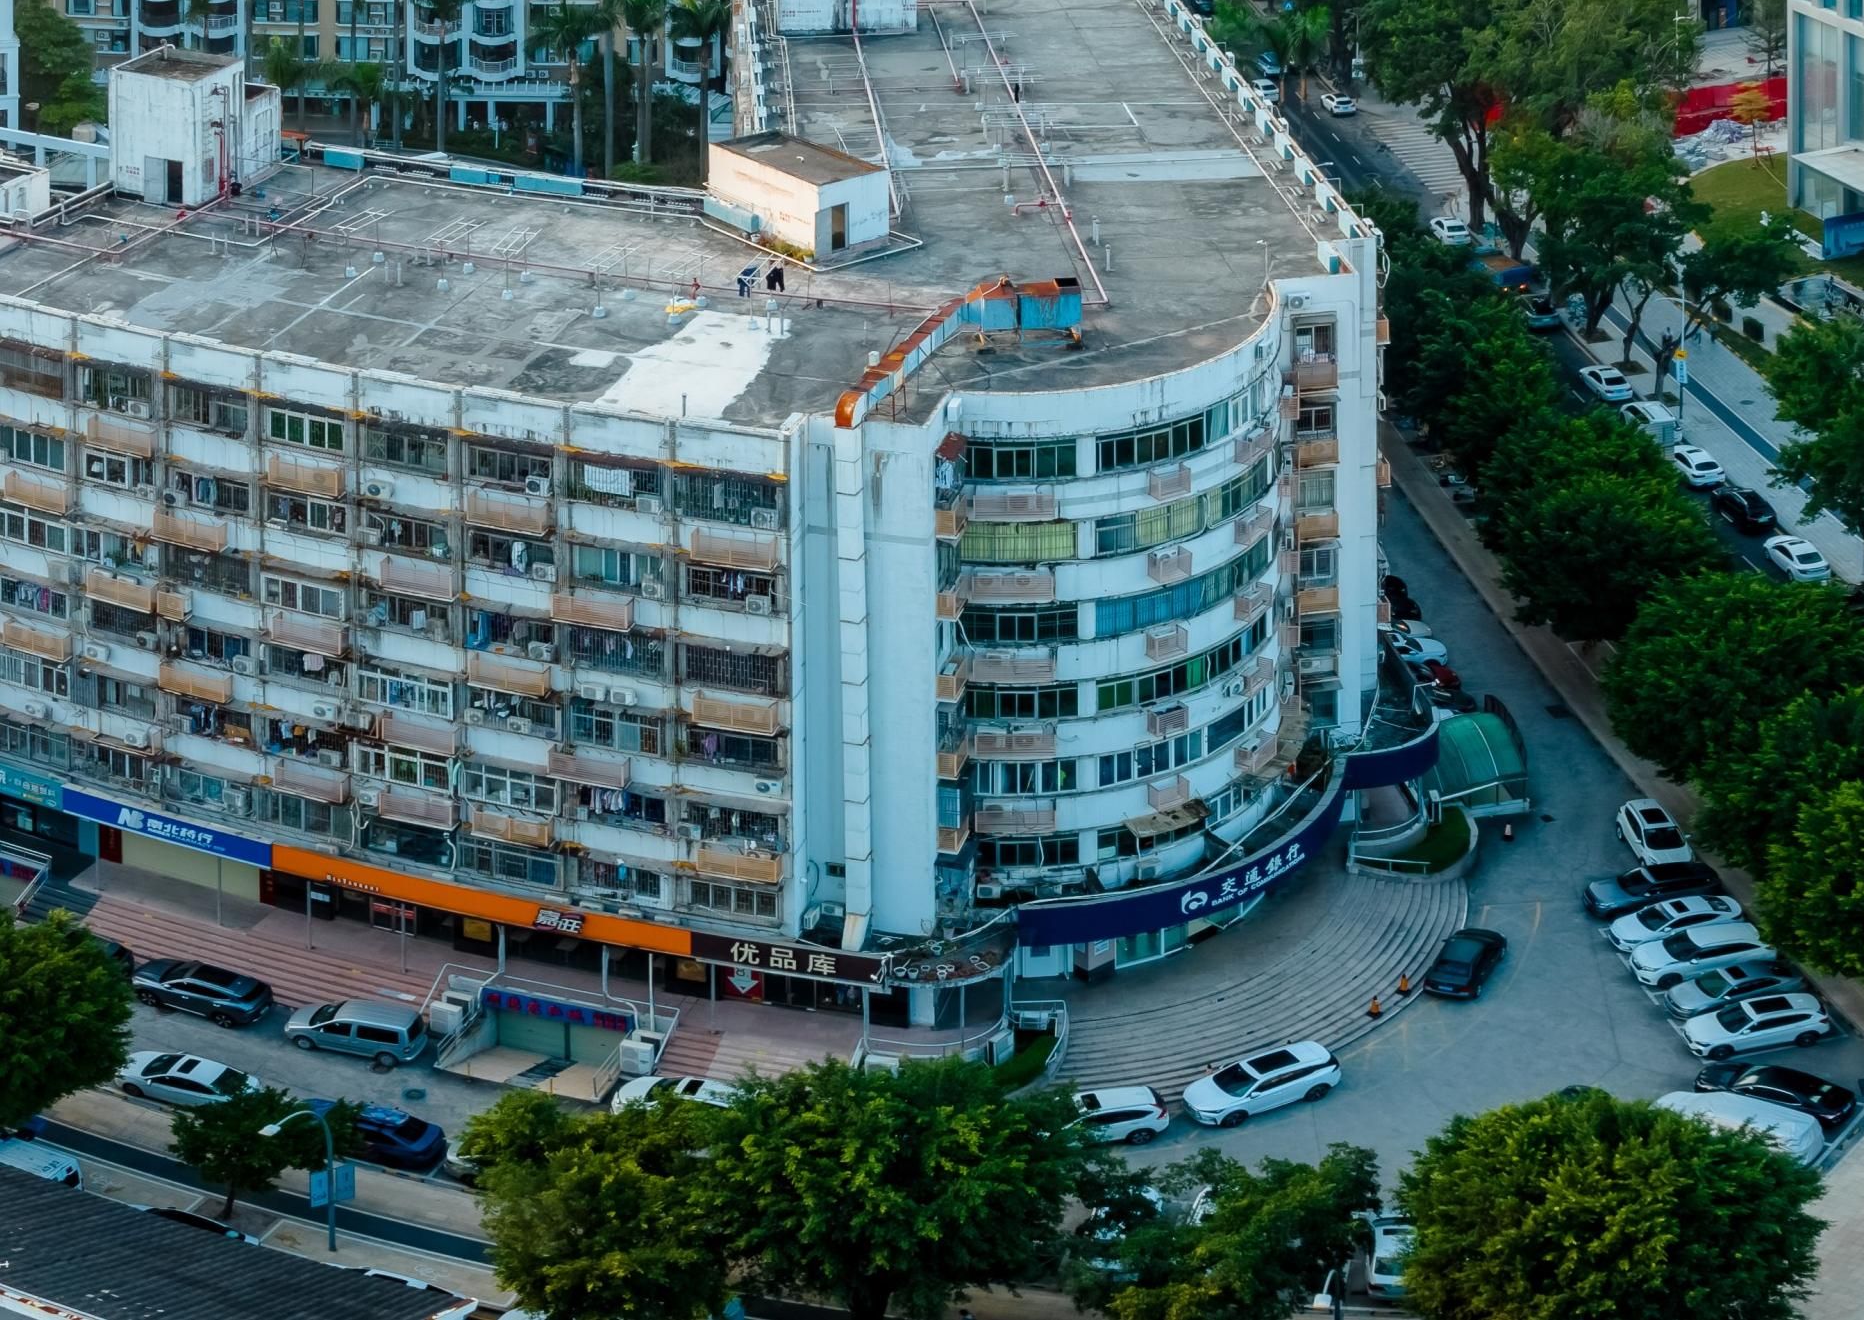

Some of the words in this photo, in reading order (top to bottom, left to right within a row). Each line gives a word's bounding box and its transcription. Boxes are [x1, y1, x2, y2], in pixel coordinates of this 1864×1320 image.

[1211, 894, 1234, 906] BANK
[1237, 887, 1249, 896] OF
[1250, 853, 1305, 890] COMMUNICATIONS
[1220, 843, 1301, 896] 交通銀行
[730, 941, 837, 976] 优品库
